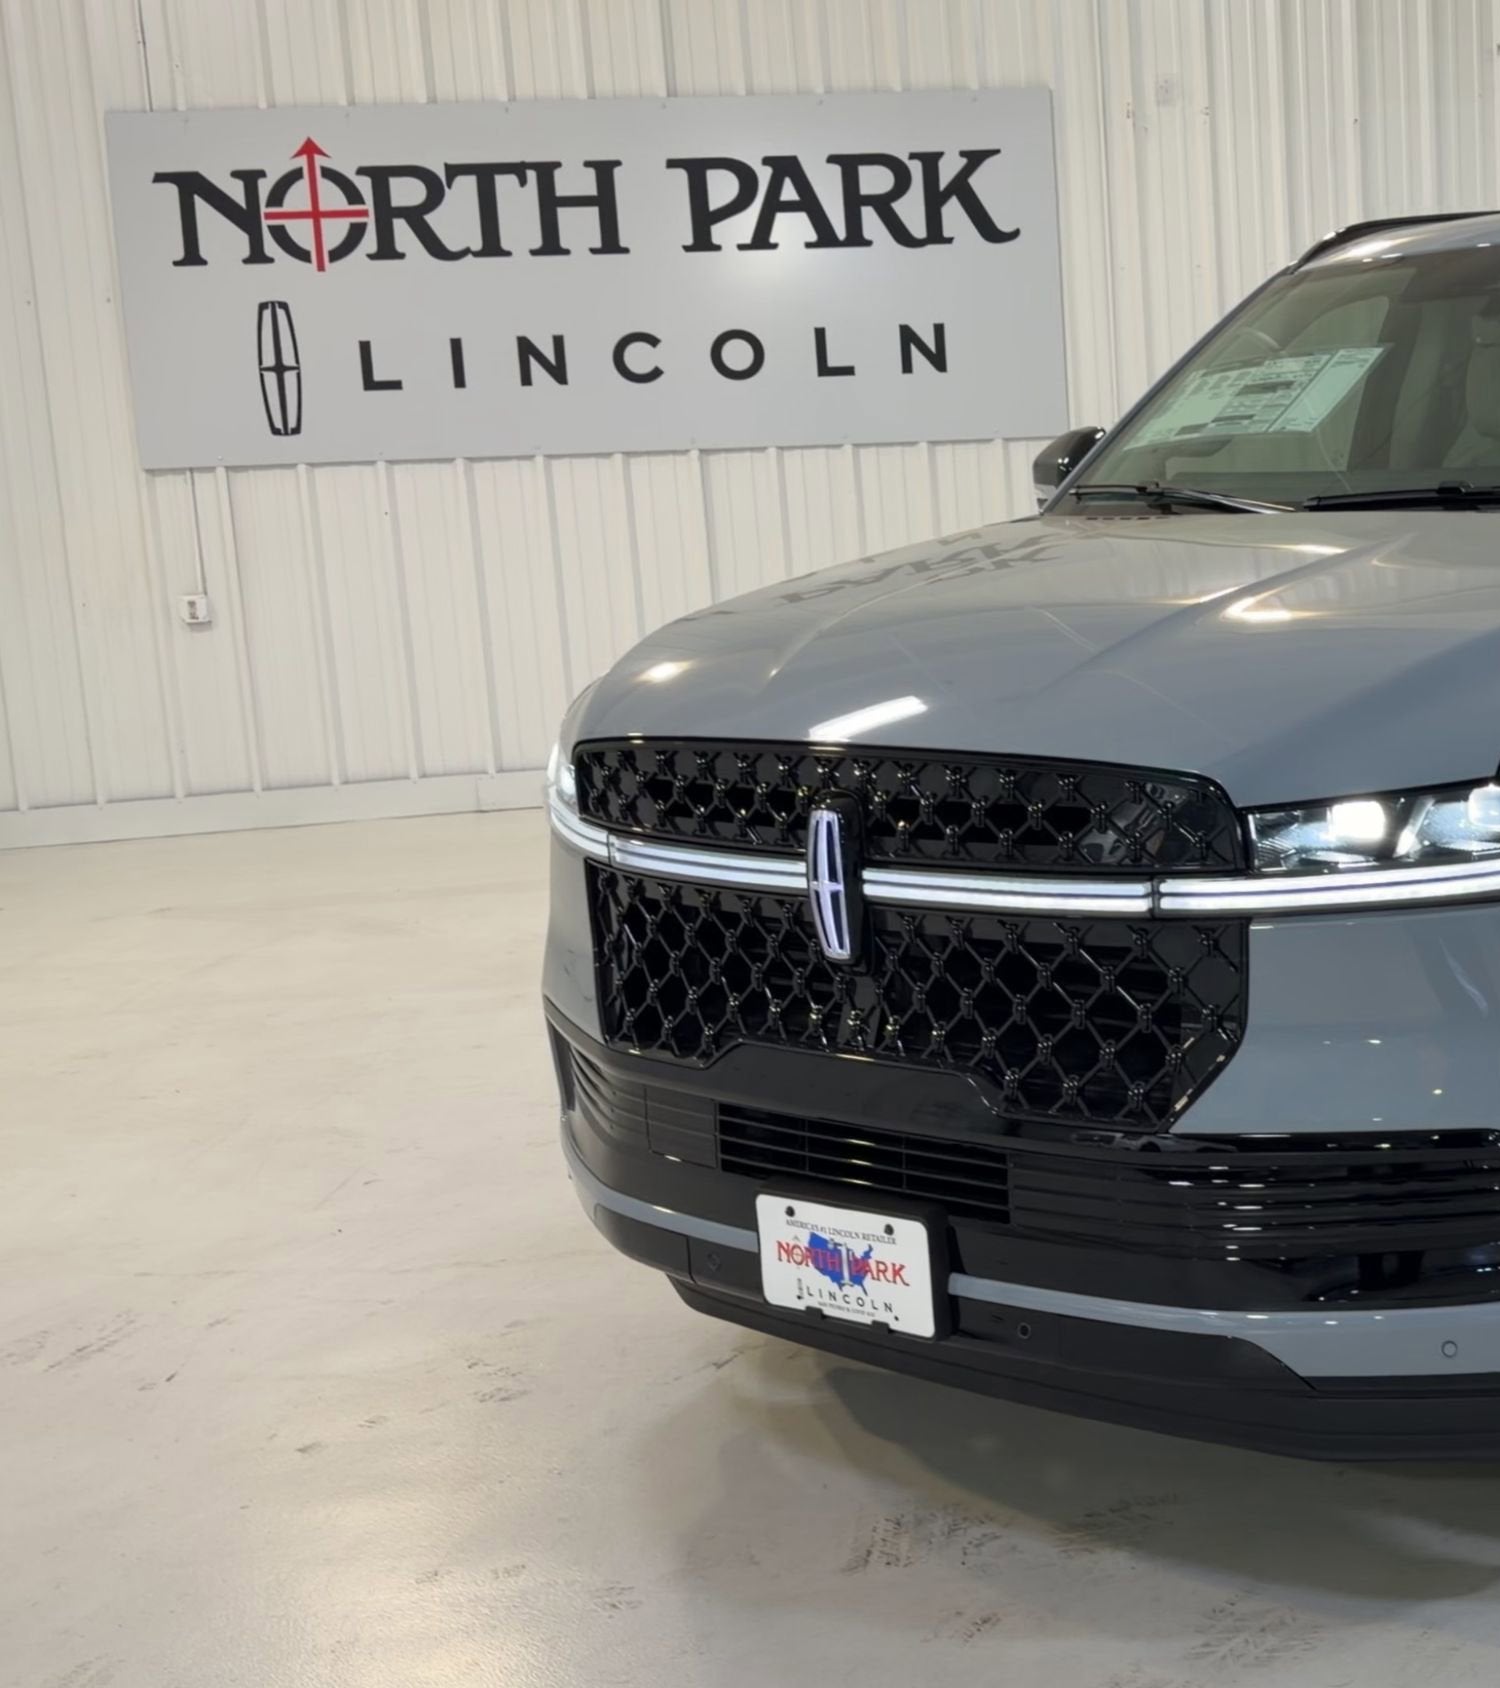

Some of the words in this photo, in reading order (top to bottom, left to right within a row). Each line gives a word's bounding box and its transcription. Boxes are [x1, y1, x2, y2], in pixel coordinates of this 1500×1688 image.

[152, 159, 630, 267] NORTH
[666, 148, 1021, 253] PARK
[358, 322, 949, 392] LINCOLN
[828, 1227, 860, 1240] LINCOLN
[862, 1233, 897, 1245] RETAILER
[777, 1241, 840, 1270] NORTH
[850, 1251, 910, 1287] PARK
[806, 1286, 893, 1313] LINCOLN
